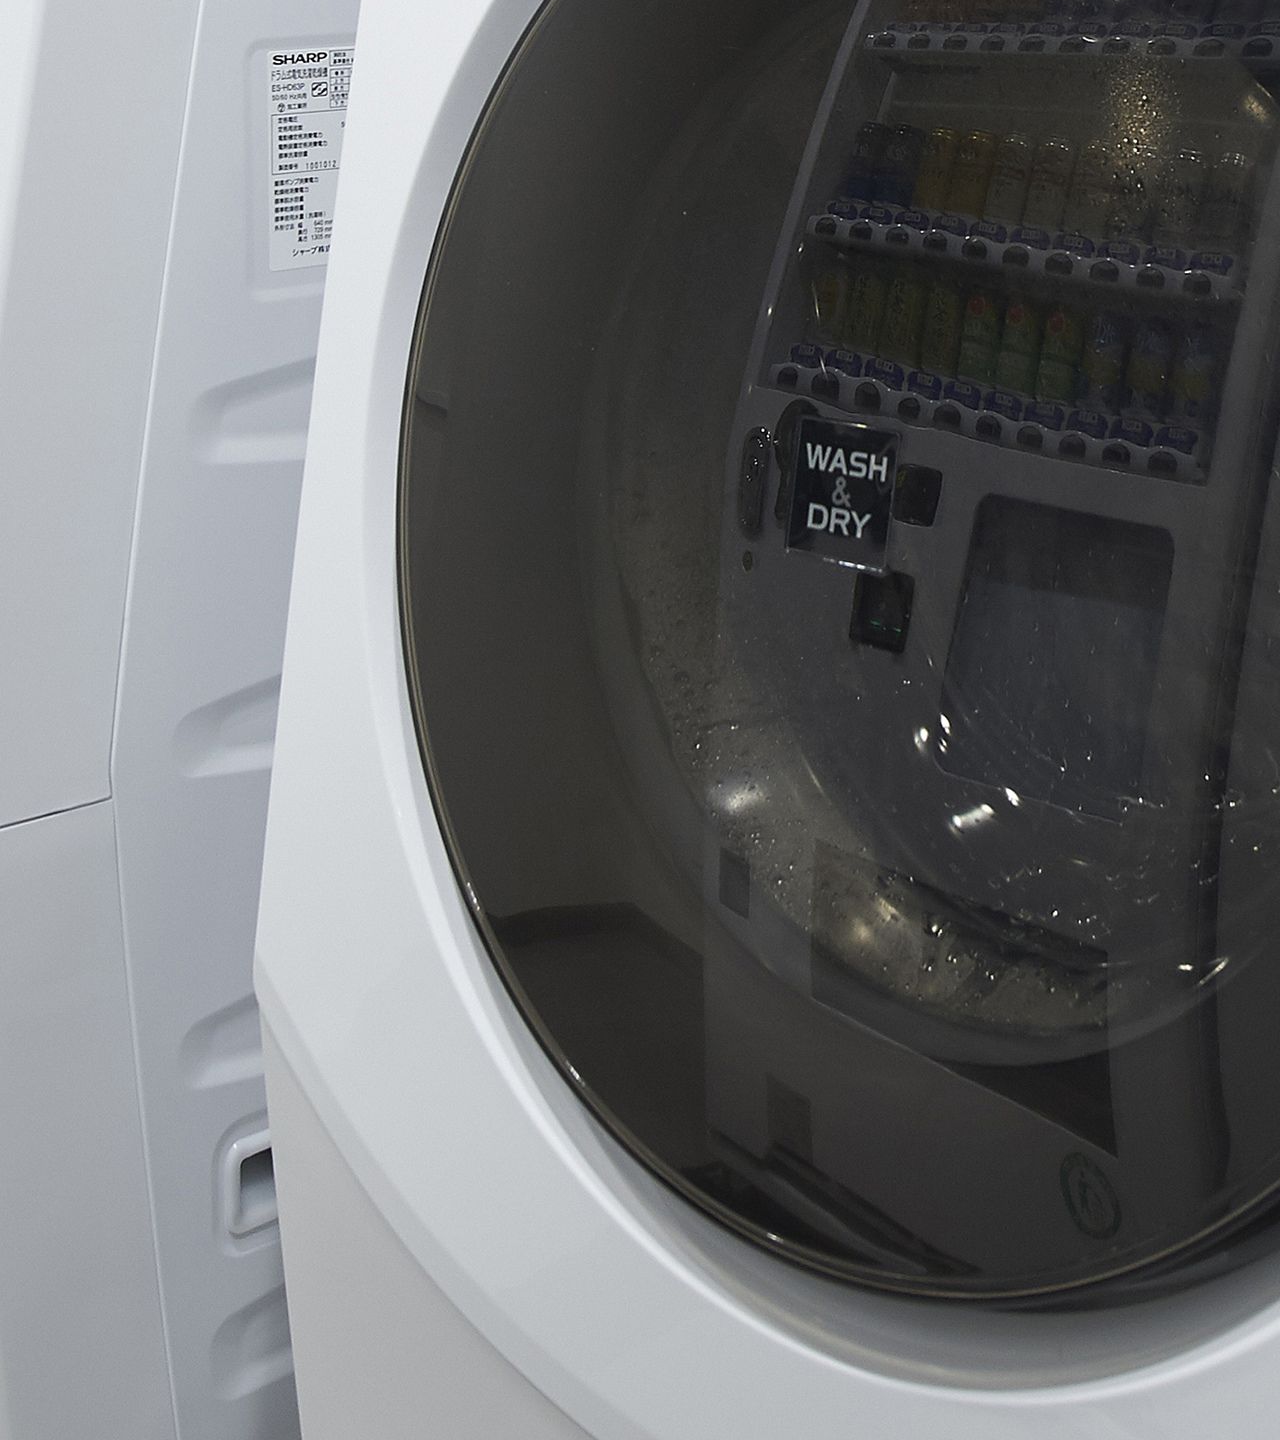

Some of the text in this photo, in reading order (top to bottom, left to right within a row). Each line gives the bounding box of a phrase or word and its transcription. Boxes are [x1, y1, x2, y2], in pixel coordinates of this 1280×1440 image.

[272, 52, 327, 65] SHARP
[806, 442, 888, 482] WASH
[832, 476, 851, 508] &
[807, 502, 871, 539] DRY
